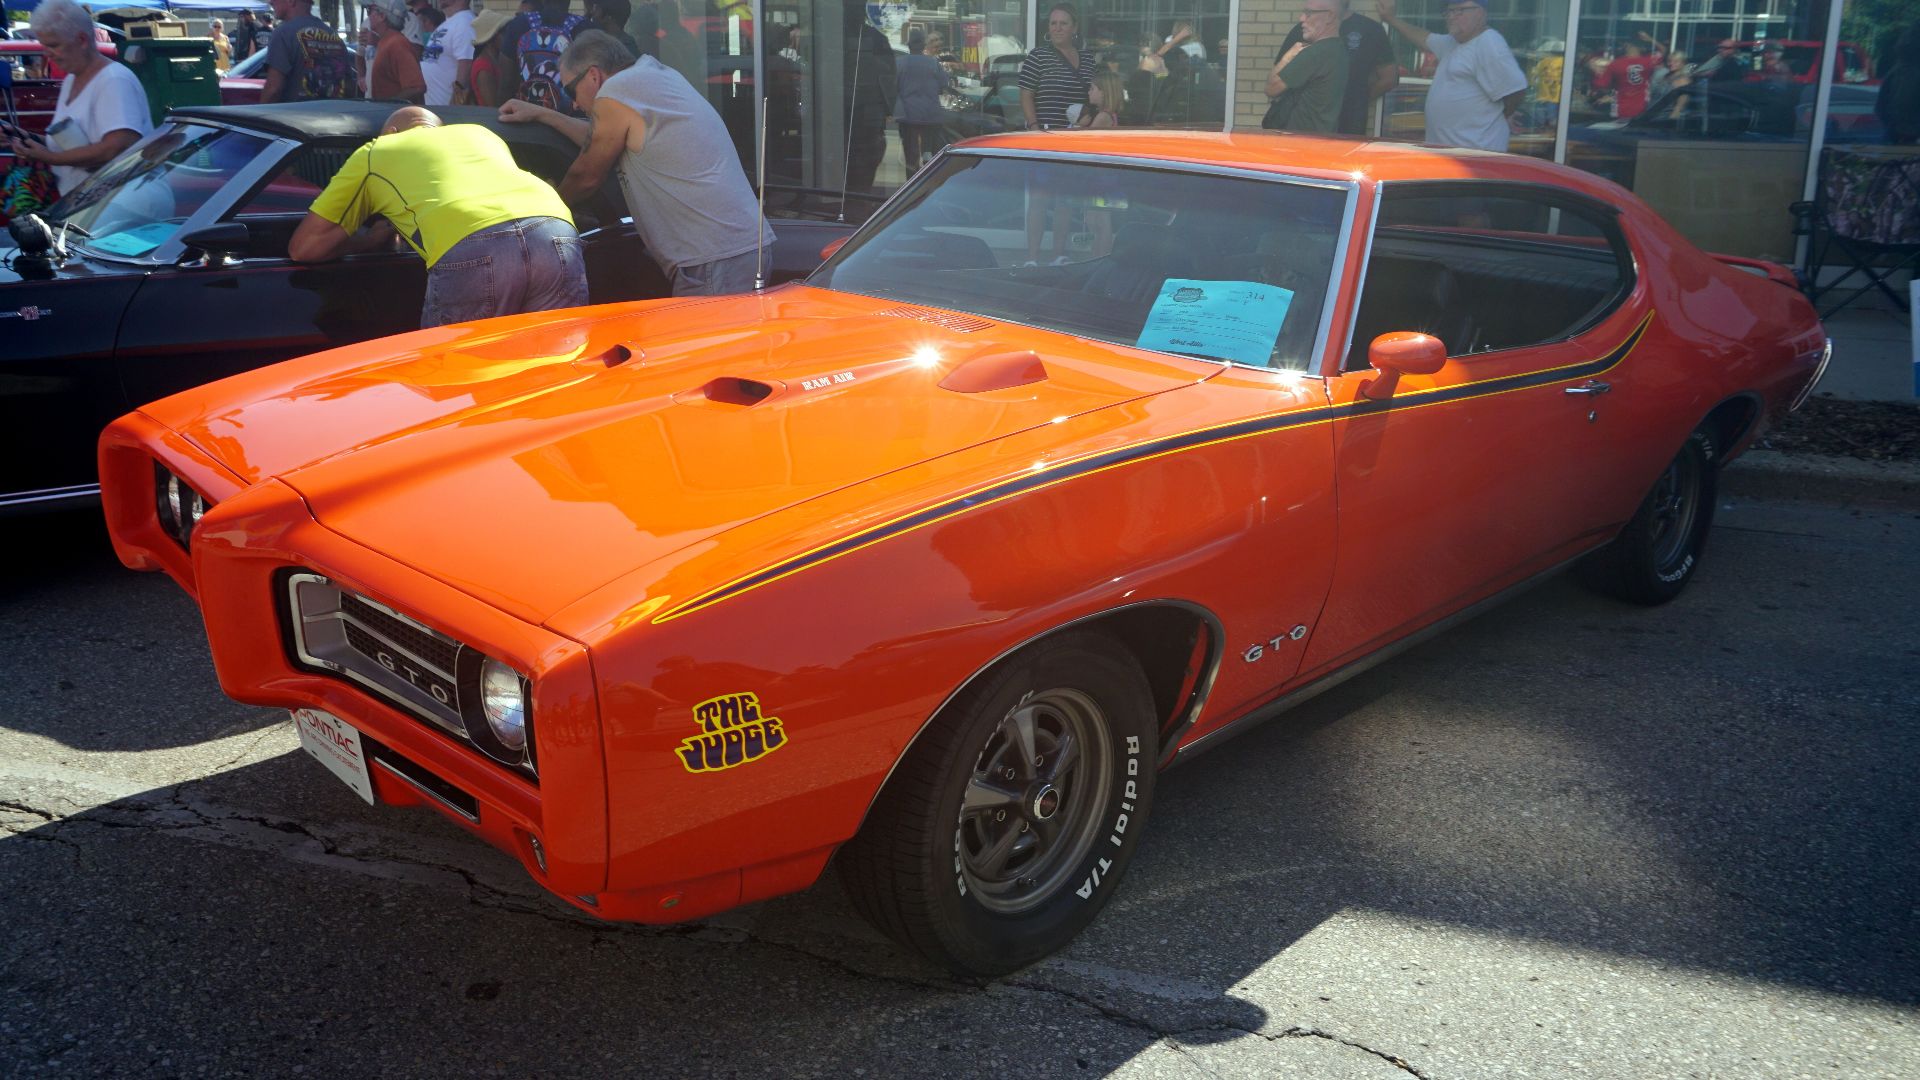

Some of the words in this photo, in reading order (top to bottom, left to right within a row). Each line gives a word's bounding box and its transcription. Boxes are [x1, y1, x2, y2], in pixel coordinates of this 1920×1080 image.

[801, 376, 832, 391] RAM
[832, 371, 856, 384] AIR
[1244, 624, 1307, 663] GTO
[377, 651, 448, 703] GTO
[694, 692, 762, 734] THE
[675, 717, 788, 773] JUDGE
[1110, 735, 1140, 847] Radial
[1076, 857, 1112, 900] T/A
